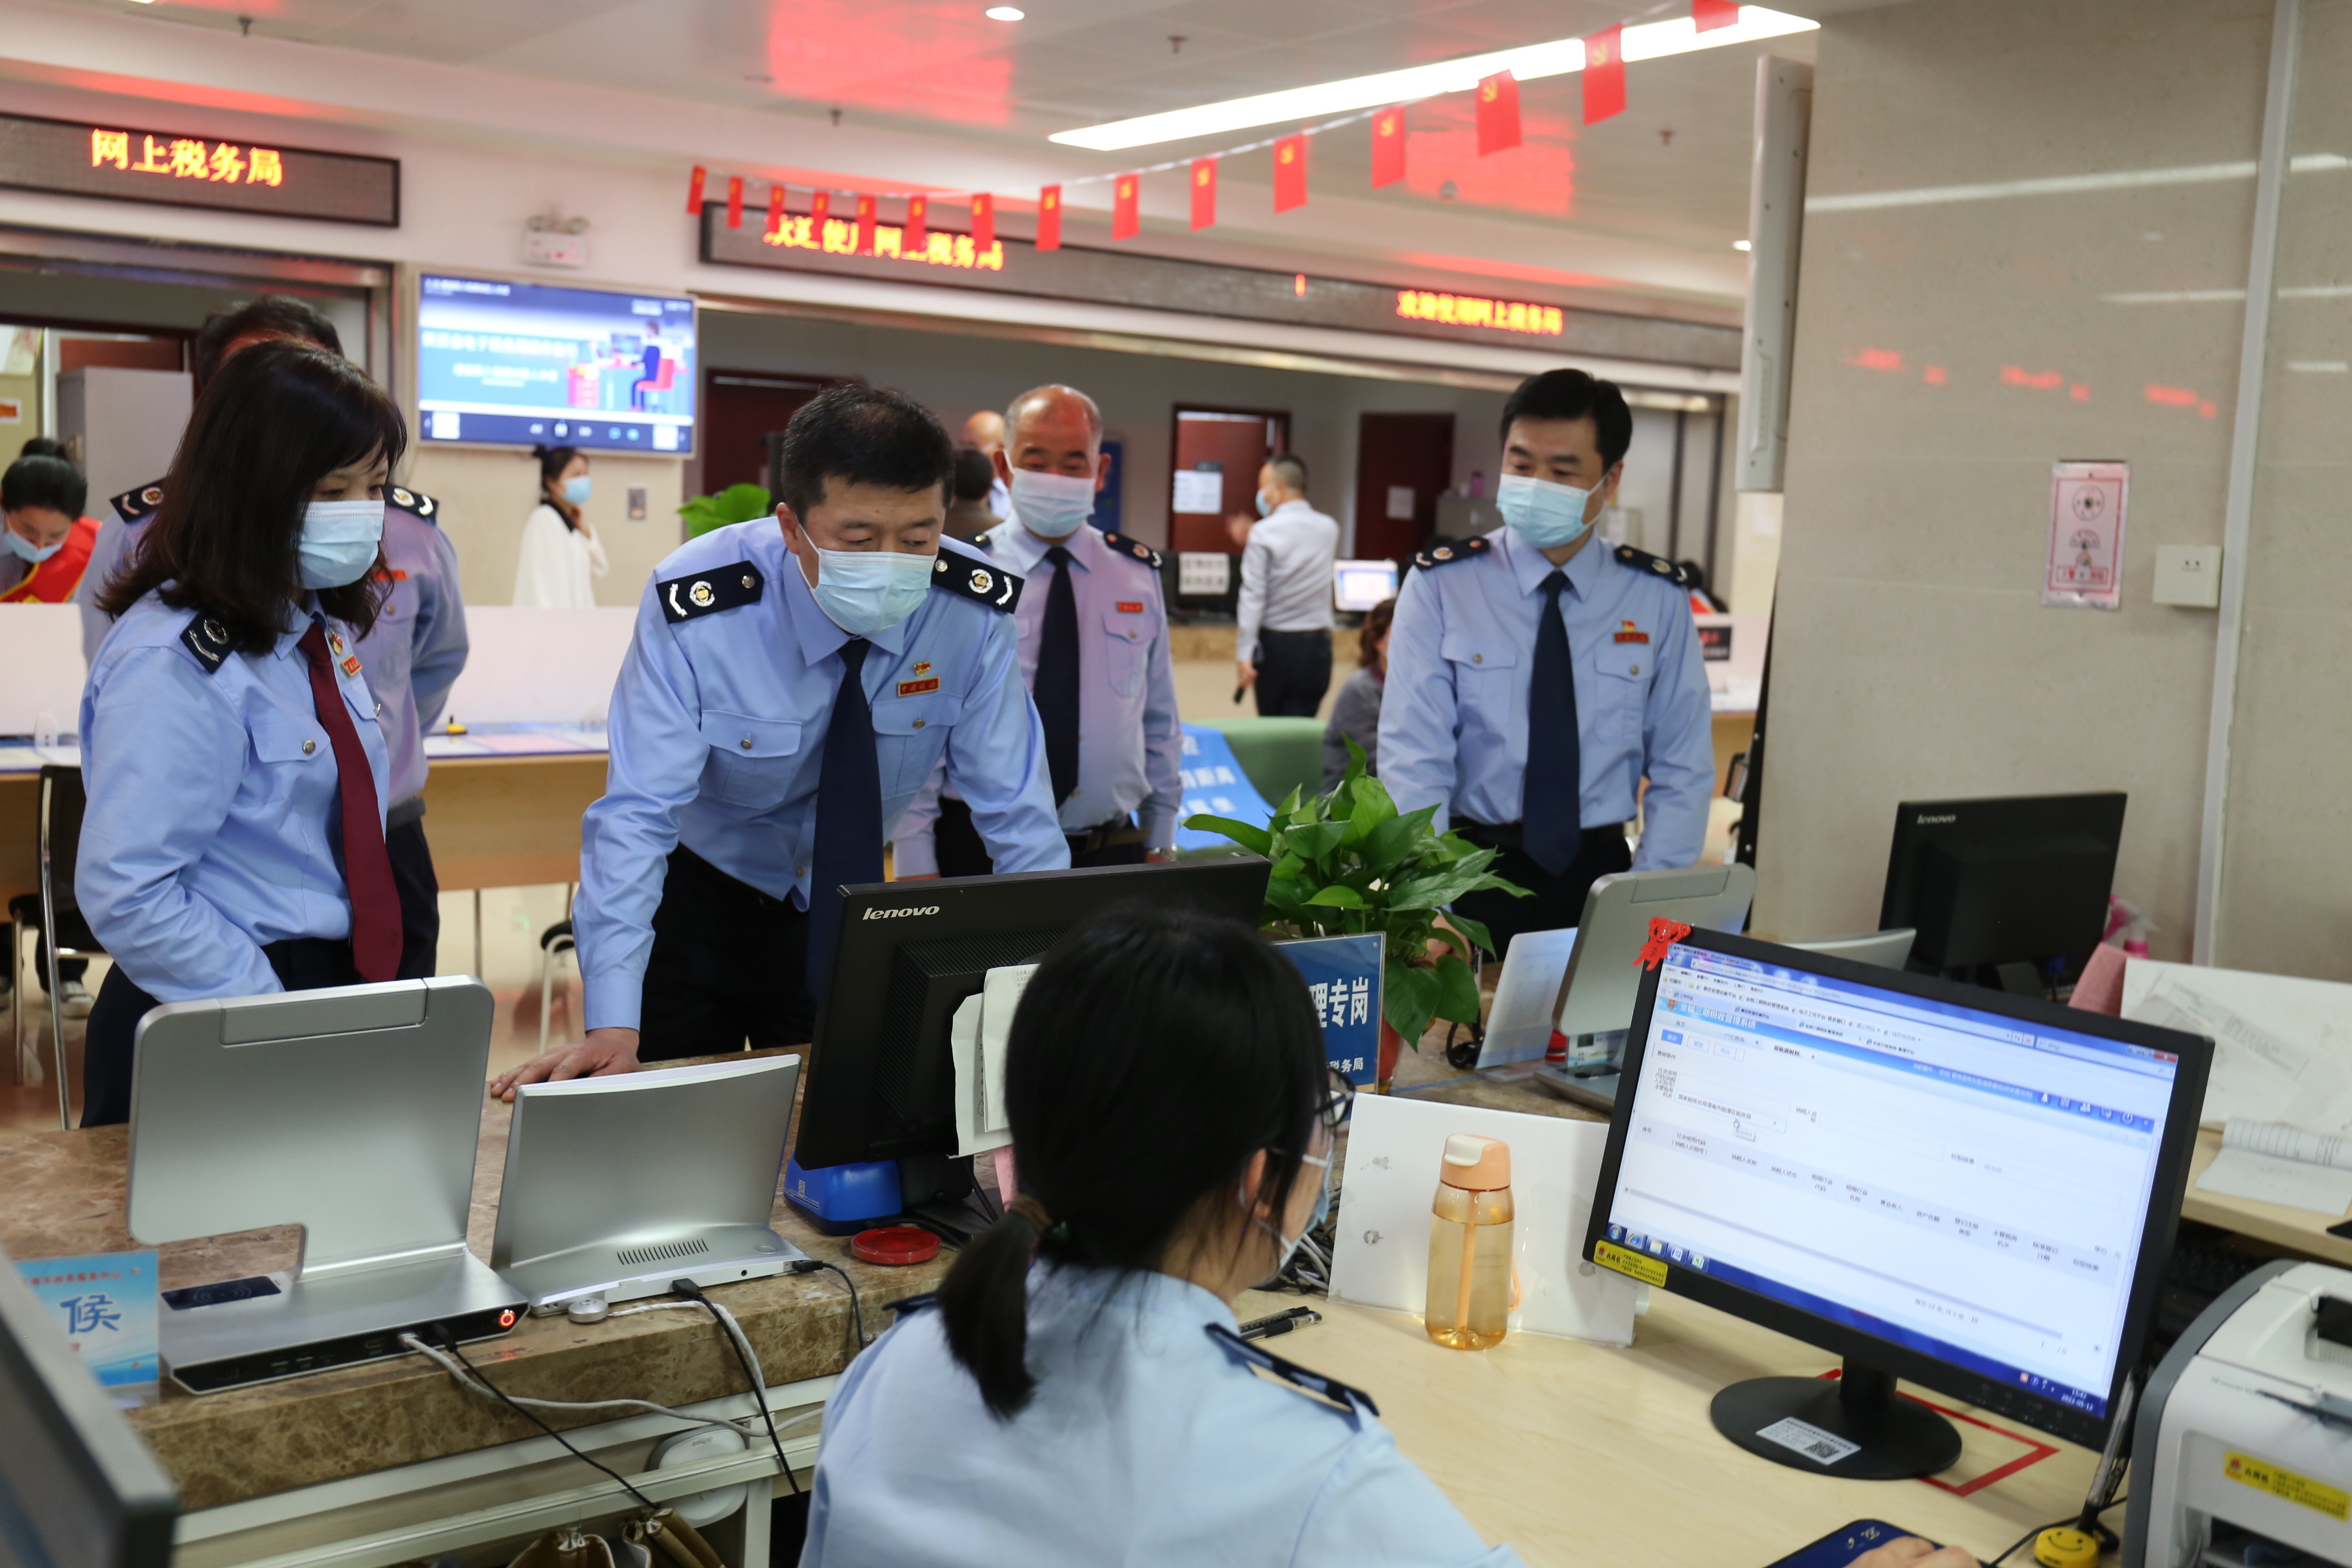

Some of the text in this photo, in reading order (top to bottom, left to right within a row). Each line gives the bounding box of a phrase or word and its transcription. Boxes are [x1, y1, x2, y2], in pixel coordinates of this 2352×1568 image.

[92, 128, 282, 187] 网上税务局
[862, 905, 940, 920] lenovo
[1680, 1001, 1756, 1028] 金税三期税收管理系统
[59, 1293, 122, 1335] 候
